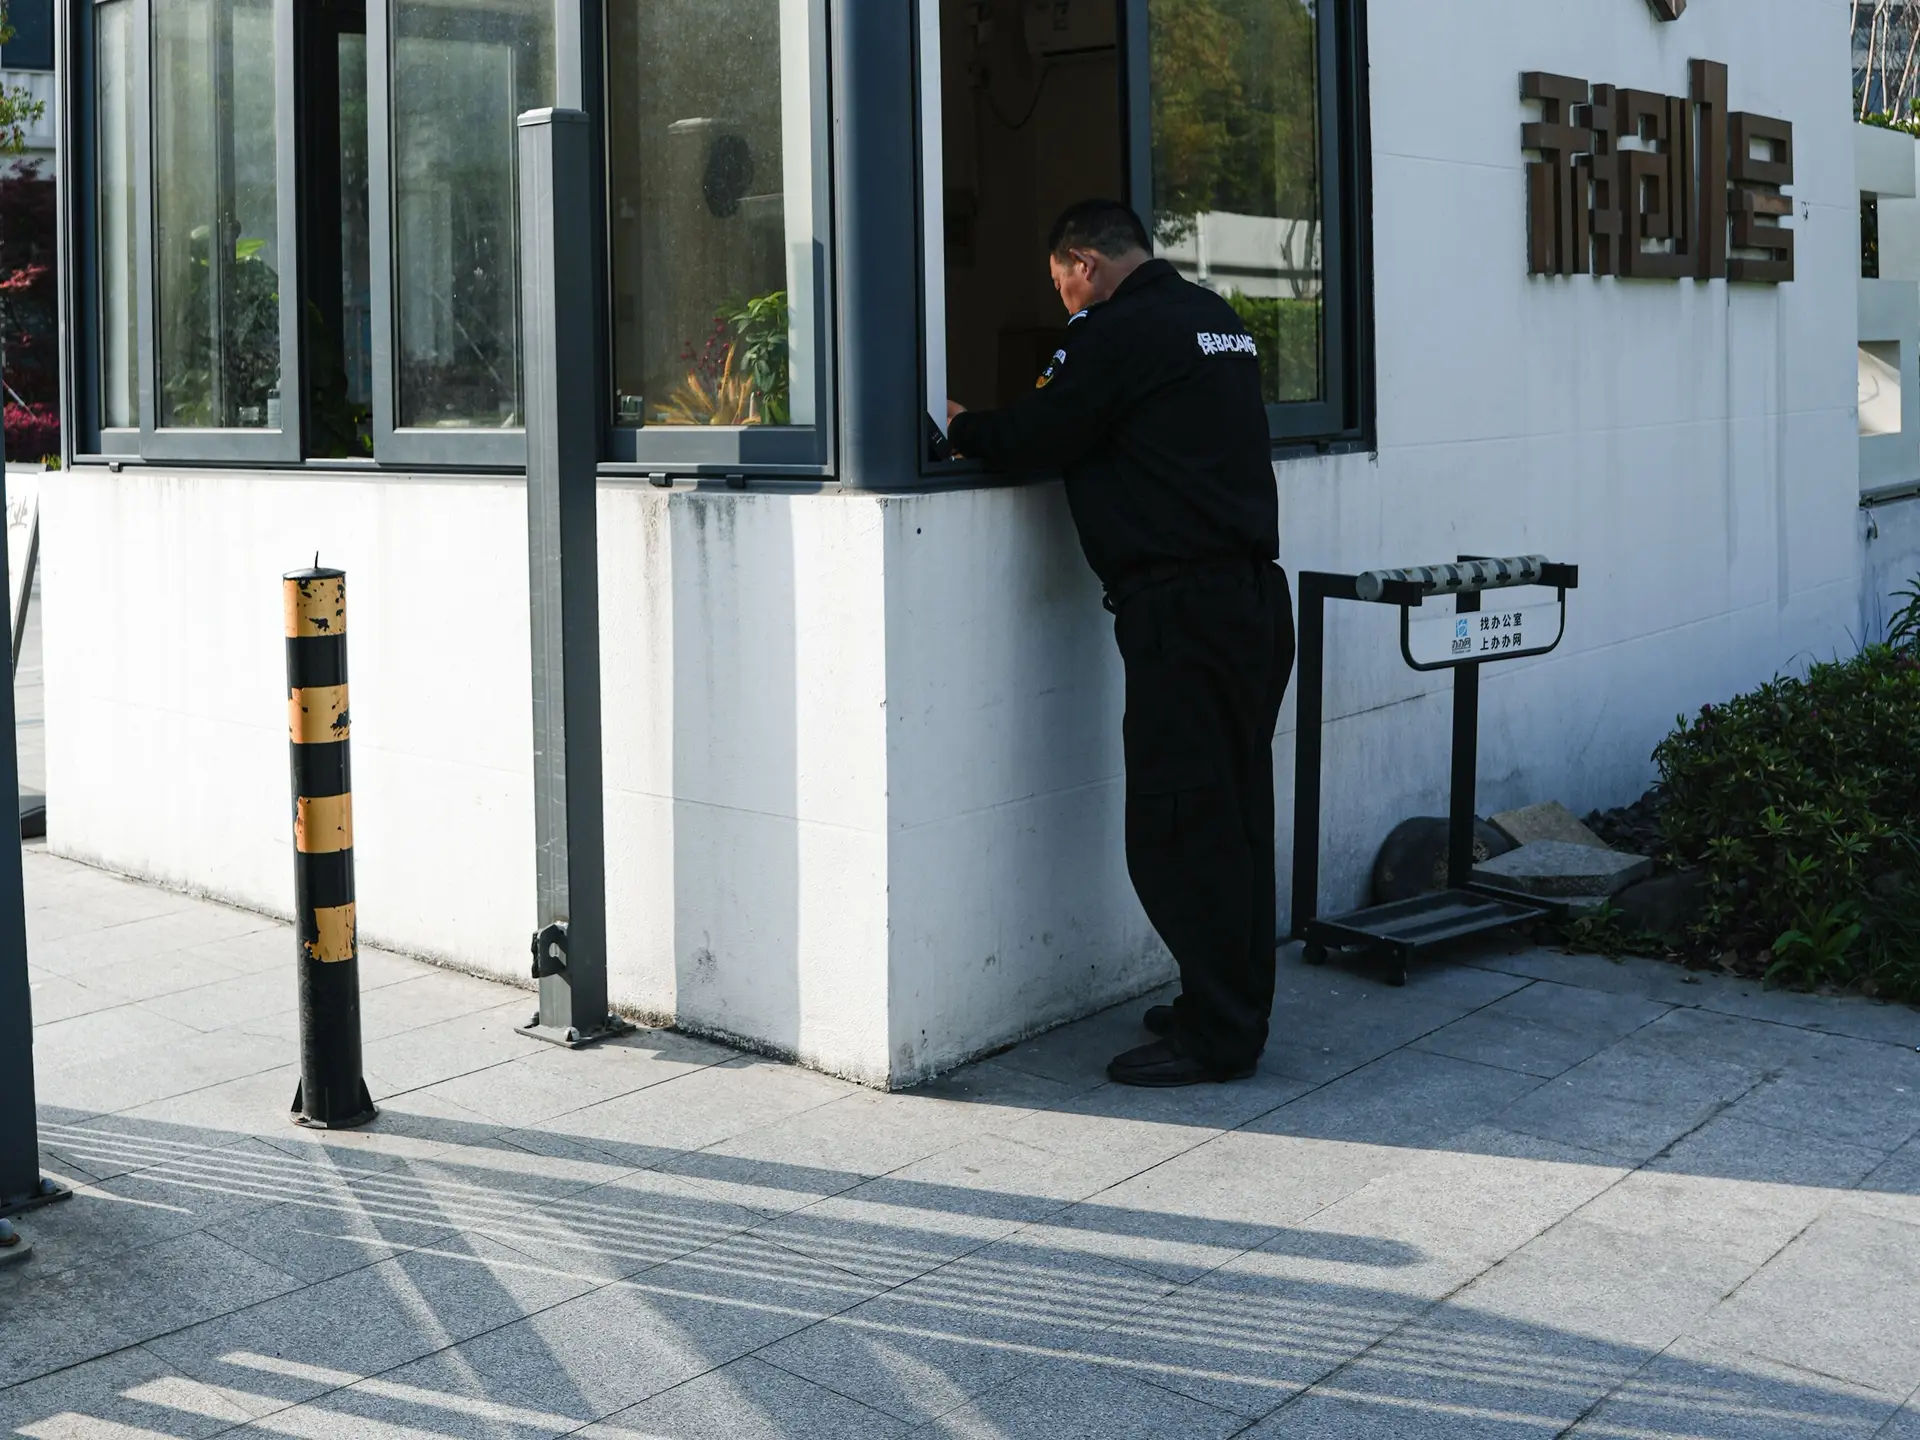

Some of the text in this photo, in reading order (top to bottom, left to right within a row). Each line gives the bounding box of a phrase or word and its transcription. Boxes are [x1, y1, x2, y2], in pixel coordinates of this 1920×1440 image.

[1480, 612, 1523, 631] 找办公室
[1480, 633, 1522, 651] 上办办网
